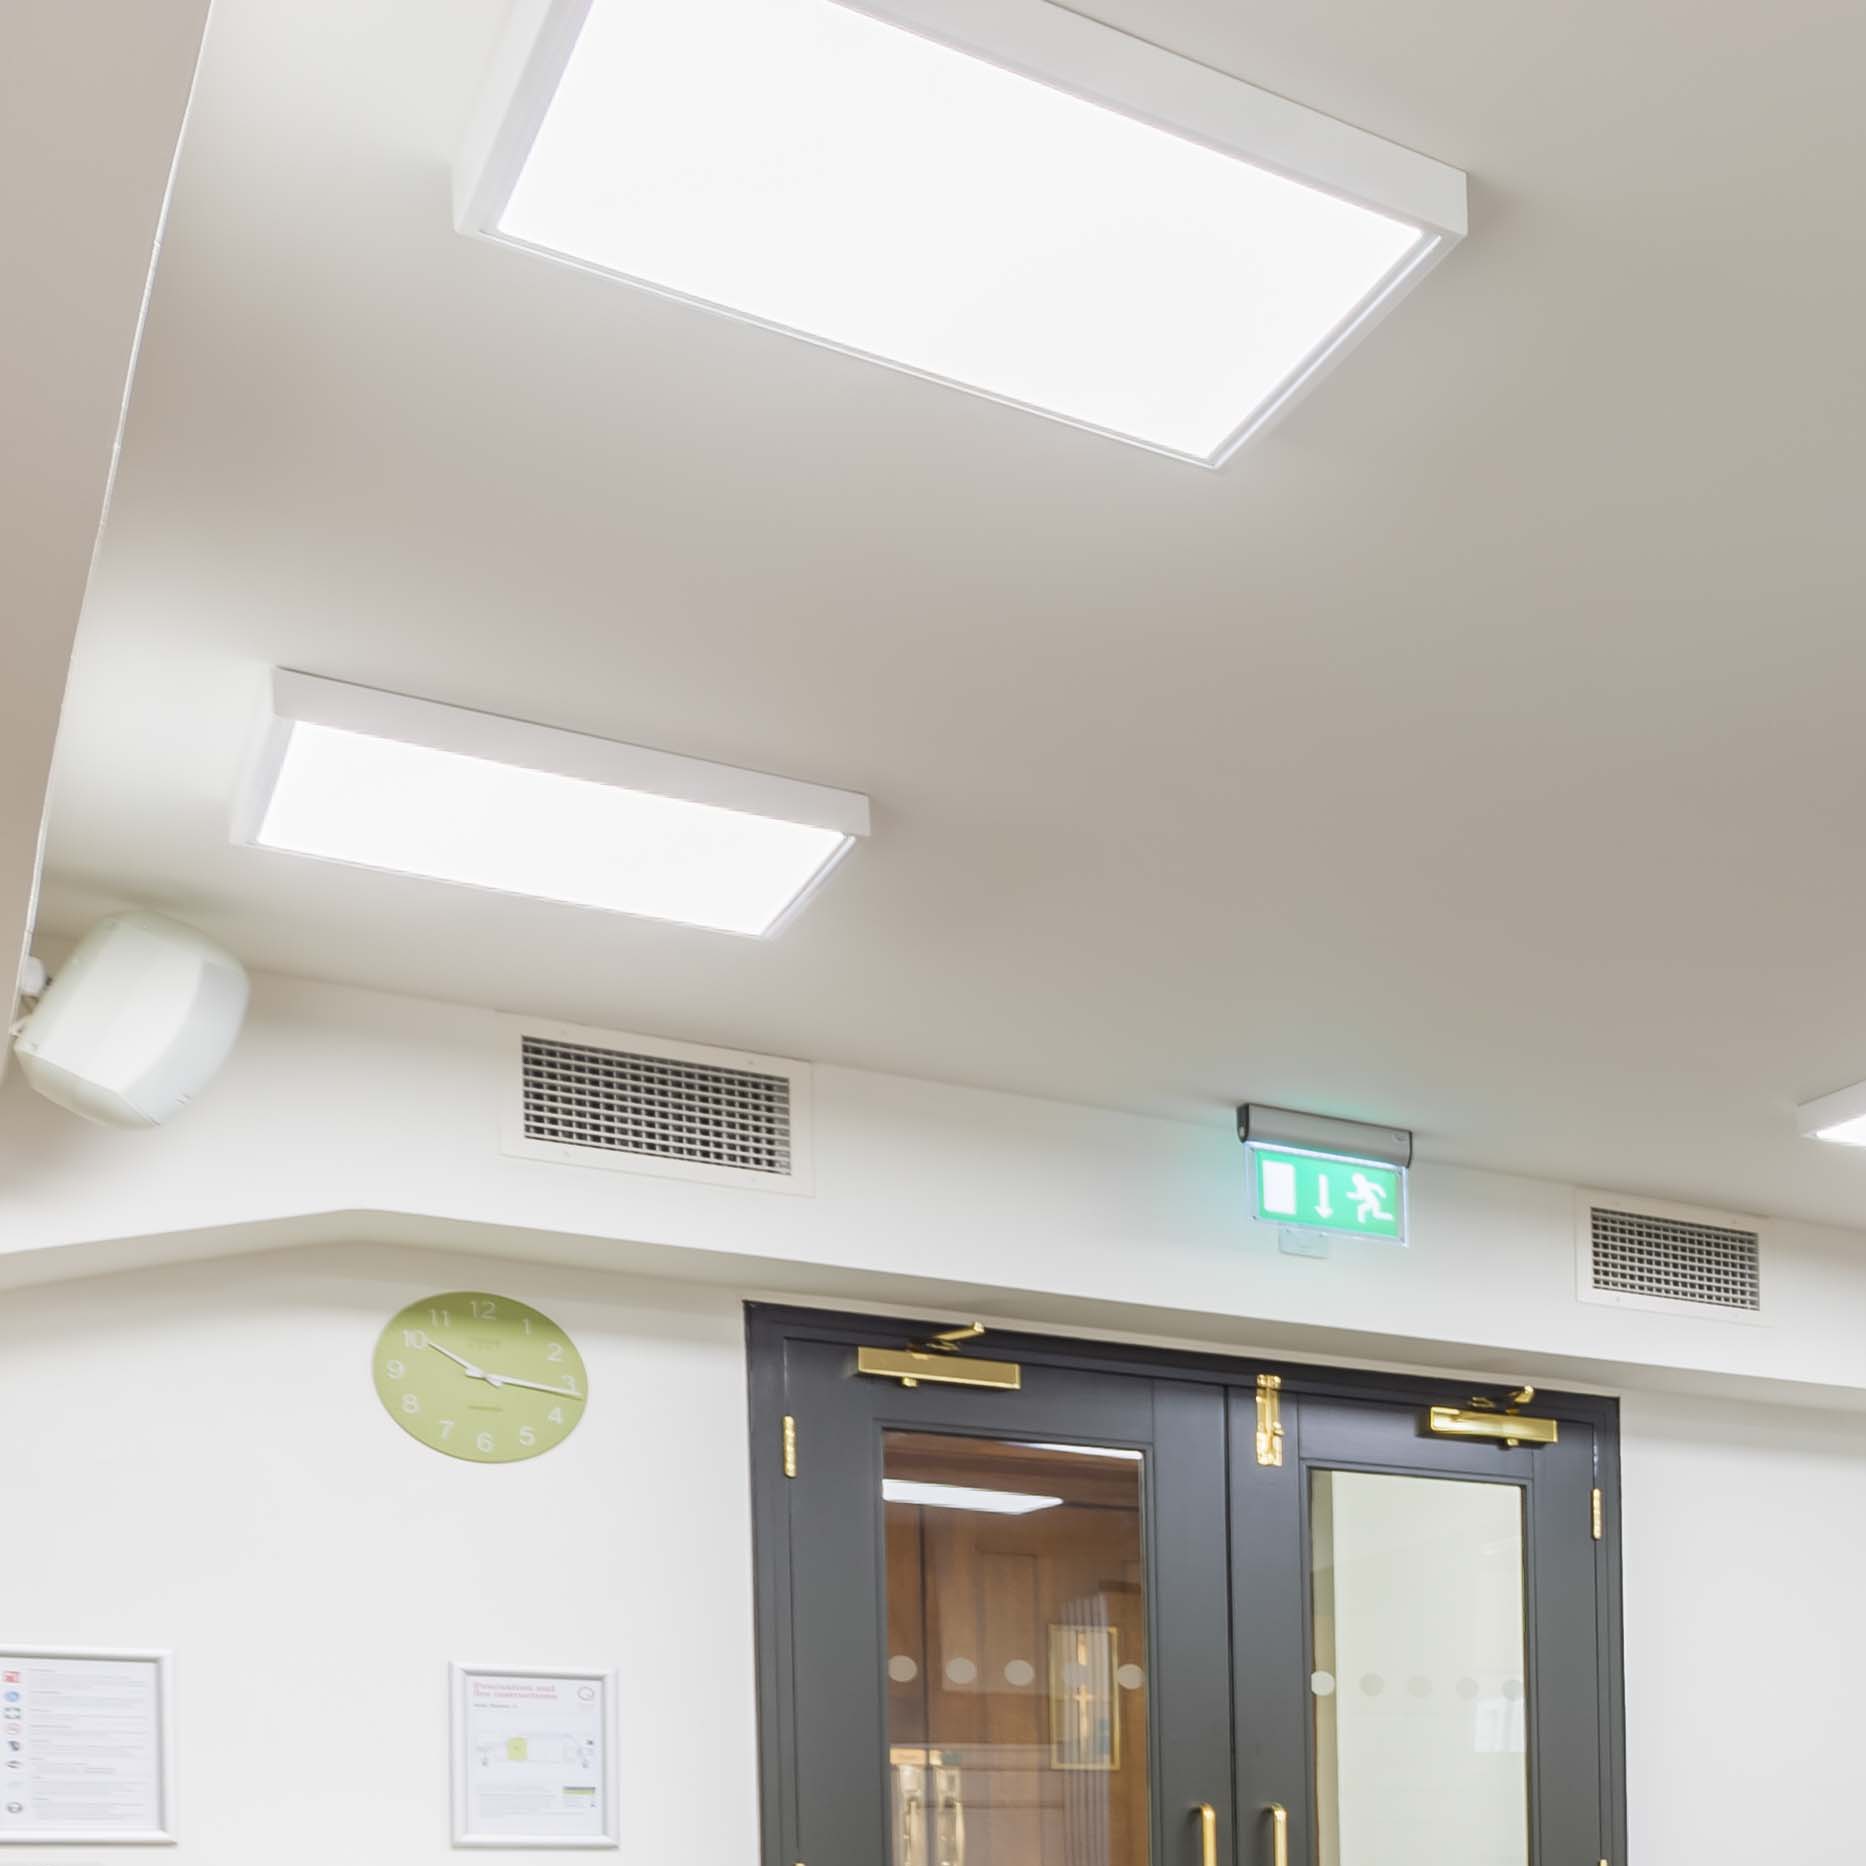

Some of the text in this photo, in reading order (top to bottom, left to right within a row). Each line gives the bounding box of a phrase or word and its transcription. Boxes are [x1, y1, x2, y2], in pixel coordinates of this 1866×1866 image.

[430, 1309, 450, 1328] 11
[470, 1300, 497, 1321] 12
[521, 1317, 532, 1335] 1
[403, 1328, 430, 1350] 10
[547, 1343, 564, 1362] 2
[387, 1359, 404, 1380] 9
[403, 1393, 420, 1414] 8
[548, 1407, 563, 1425] 4
[438, 1418, 455, 1441] 7
[519, 1425, 536, 1447] 5
[477, 1431, 494, 1453] 6
